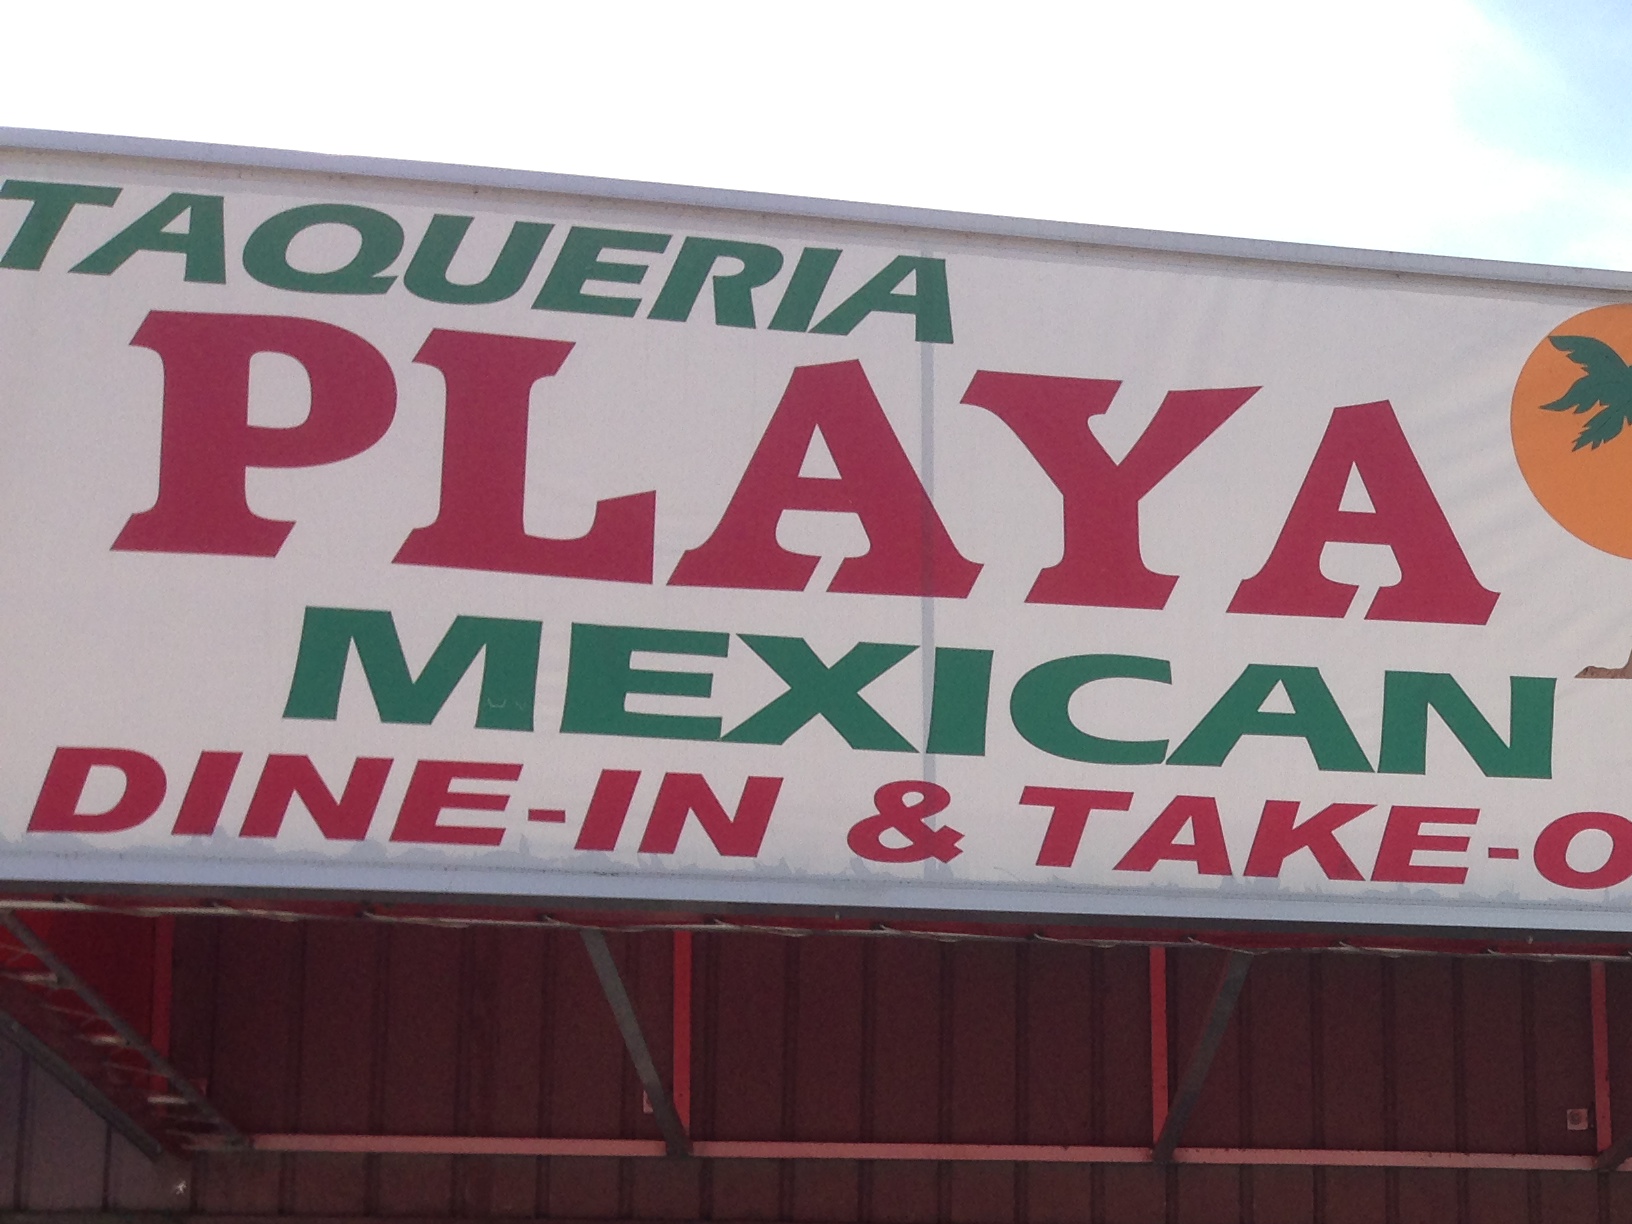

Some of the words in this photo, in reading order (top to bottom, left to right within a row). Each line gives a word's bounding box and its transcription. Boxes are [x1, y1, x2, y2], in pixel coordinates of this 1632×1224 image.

[0, 178, 955, 345] TAQUERIA
[109, 308, 1501, 626] PLAYA
[282, 605, 1555, 780] MEXICAN
[27, 745, 784, 858] DINE-IN
[847, 779, 963, 864] &
